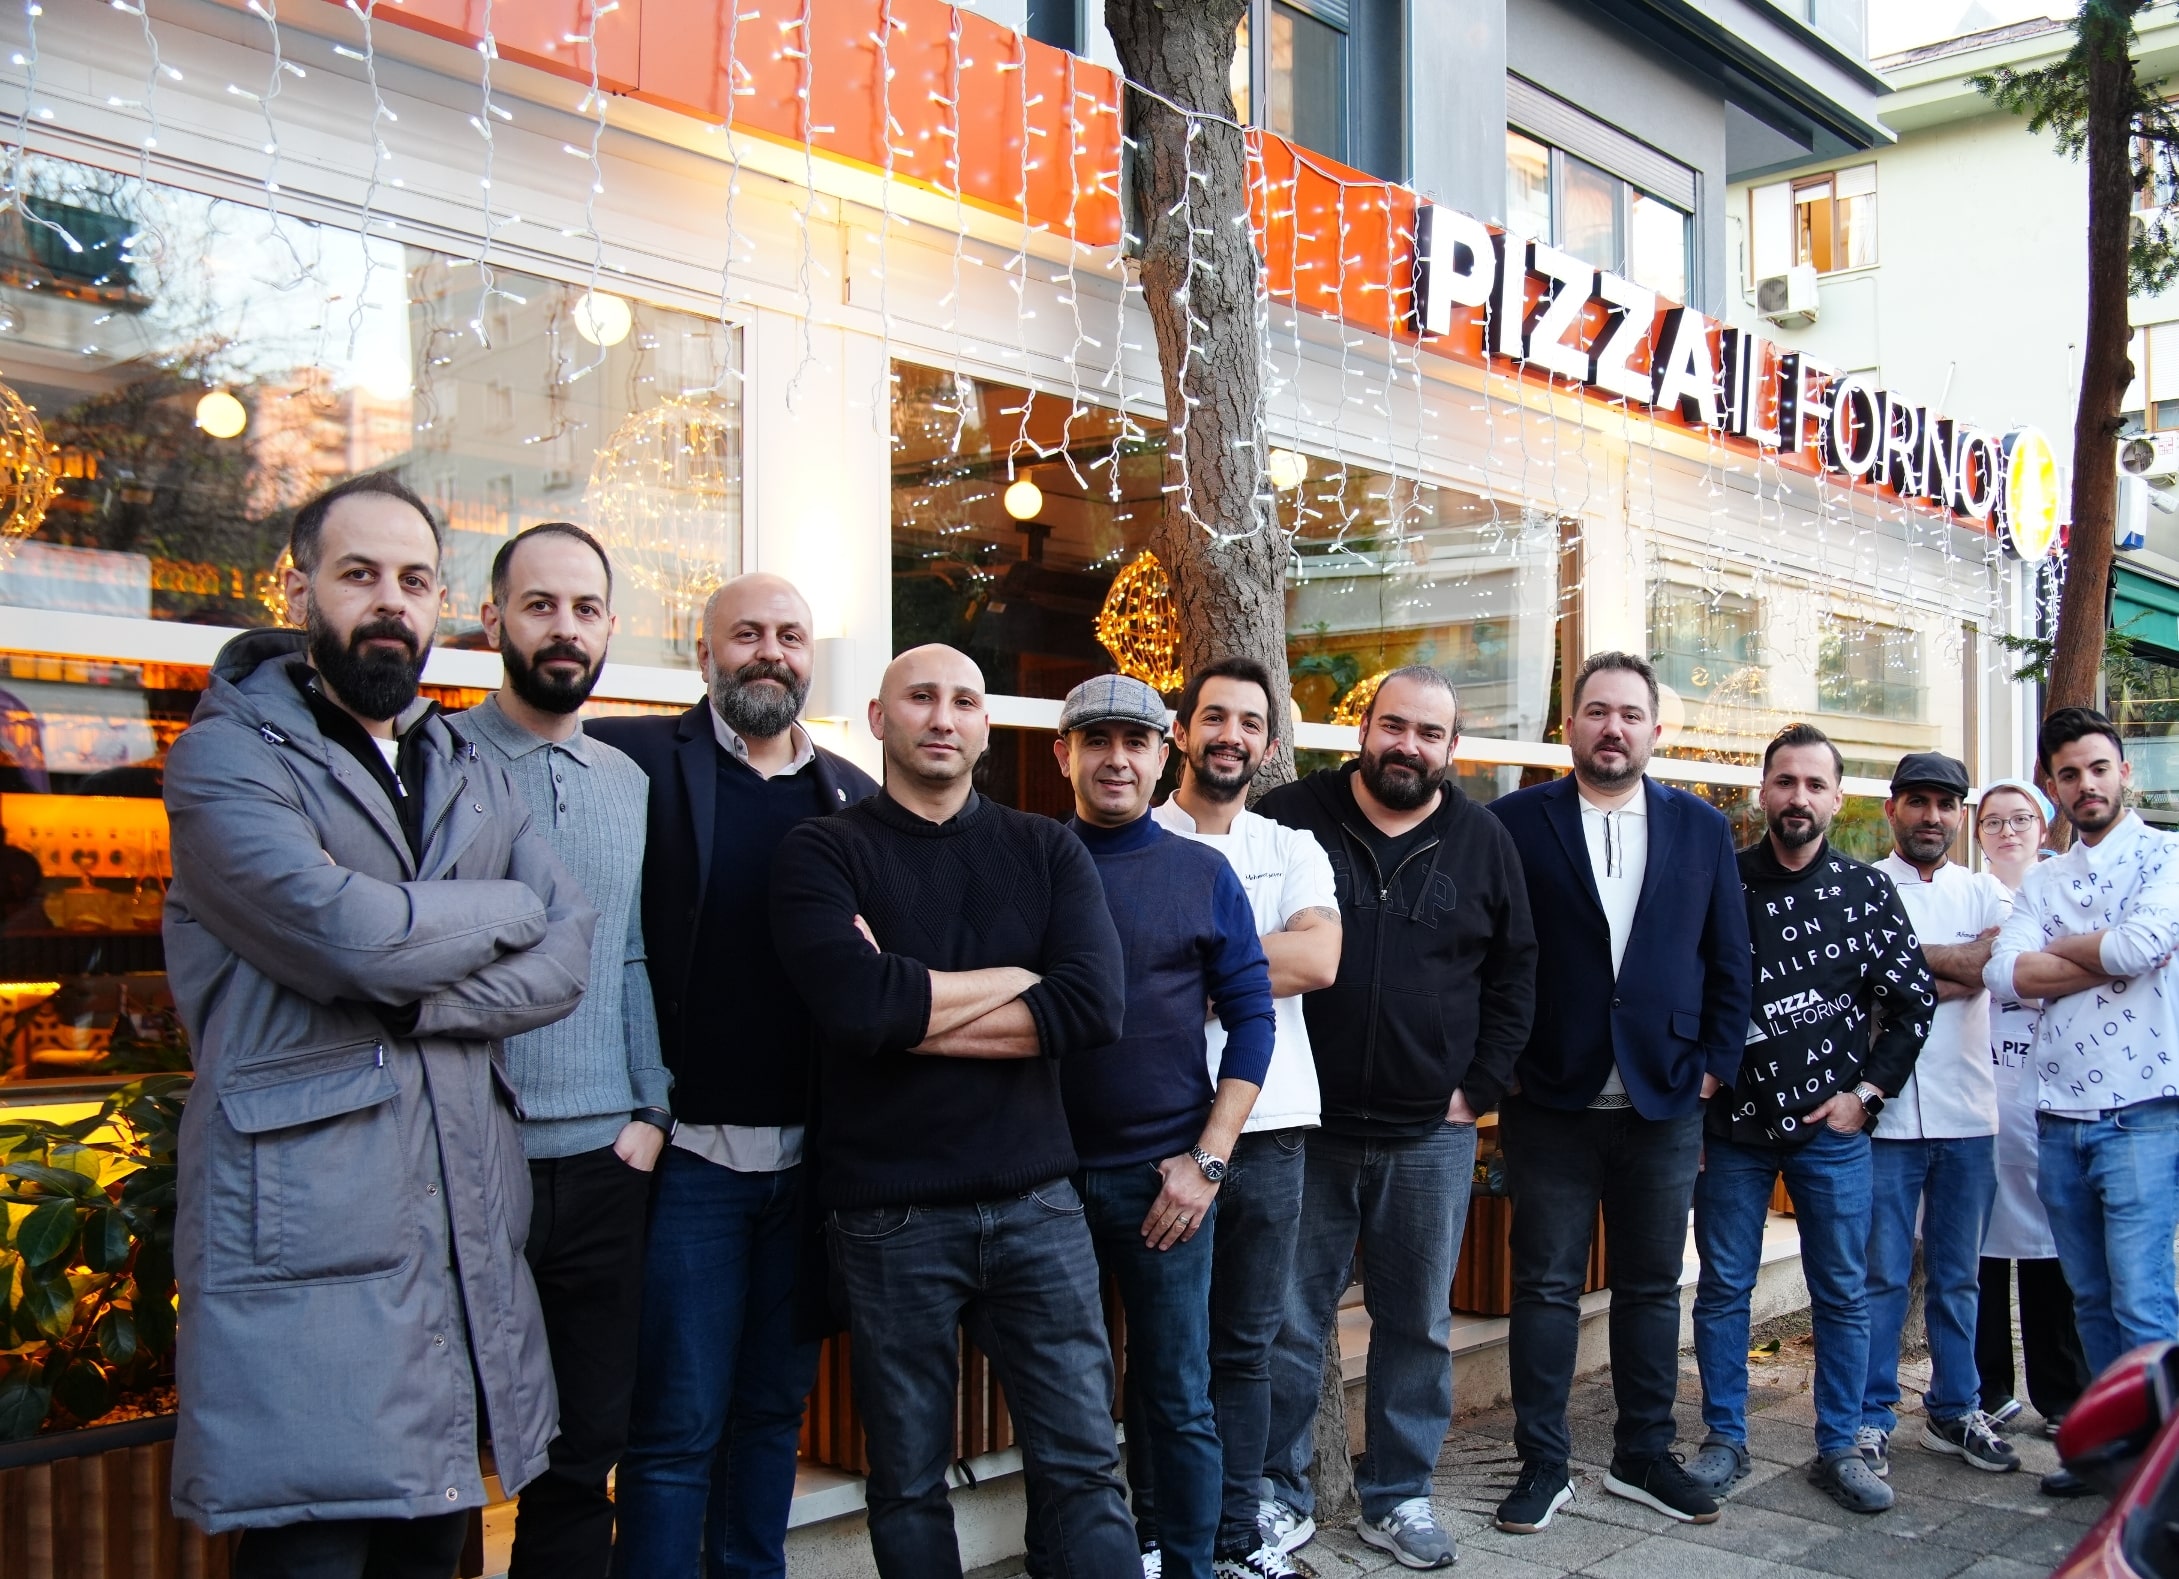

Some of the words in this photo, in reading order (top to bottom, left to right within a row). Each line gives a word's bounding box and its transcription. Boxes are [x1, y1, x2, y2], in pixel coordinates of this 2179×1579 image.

[1424, 203, 1720, 427] PIZZA
[1732, 327, 1782, 447] IL
[1794, 351, 1998, 520] FORNO
[1762, 988, 1824, 1020] PIZZA
[1769, 1020, 1789, 1037] IL
[1790, 993, 1852, 1029] FORNO
